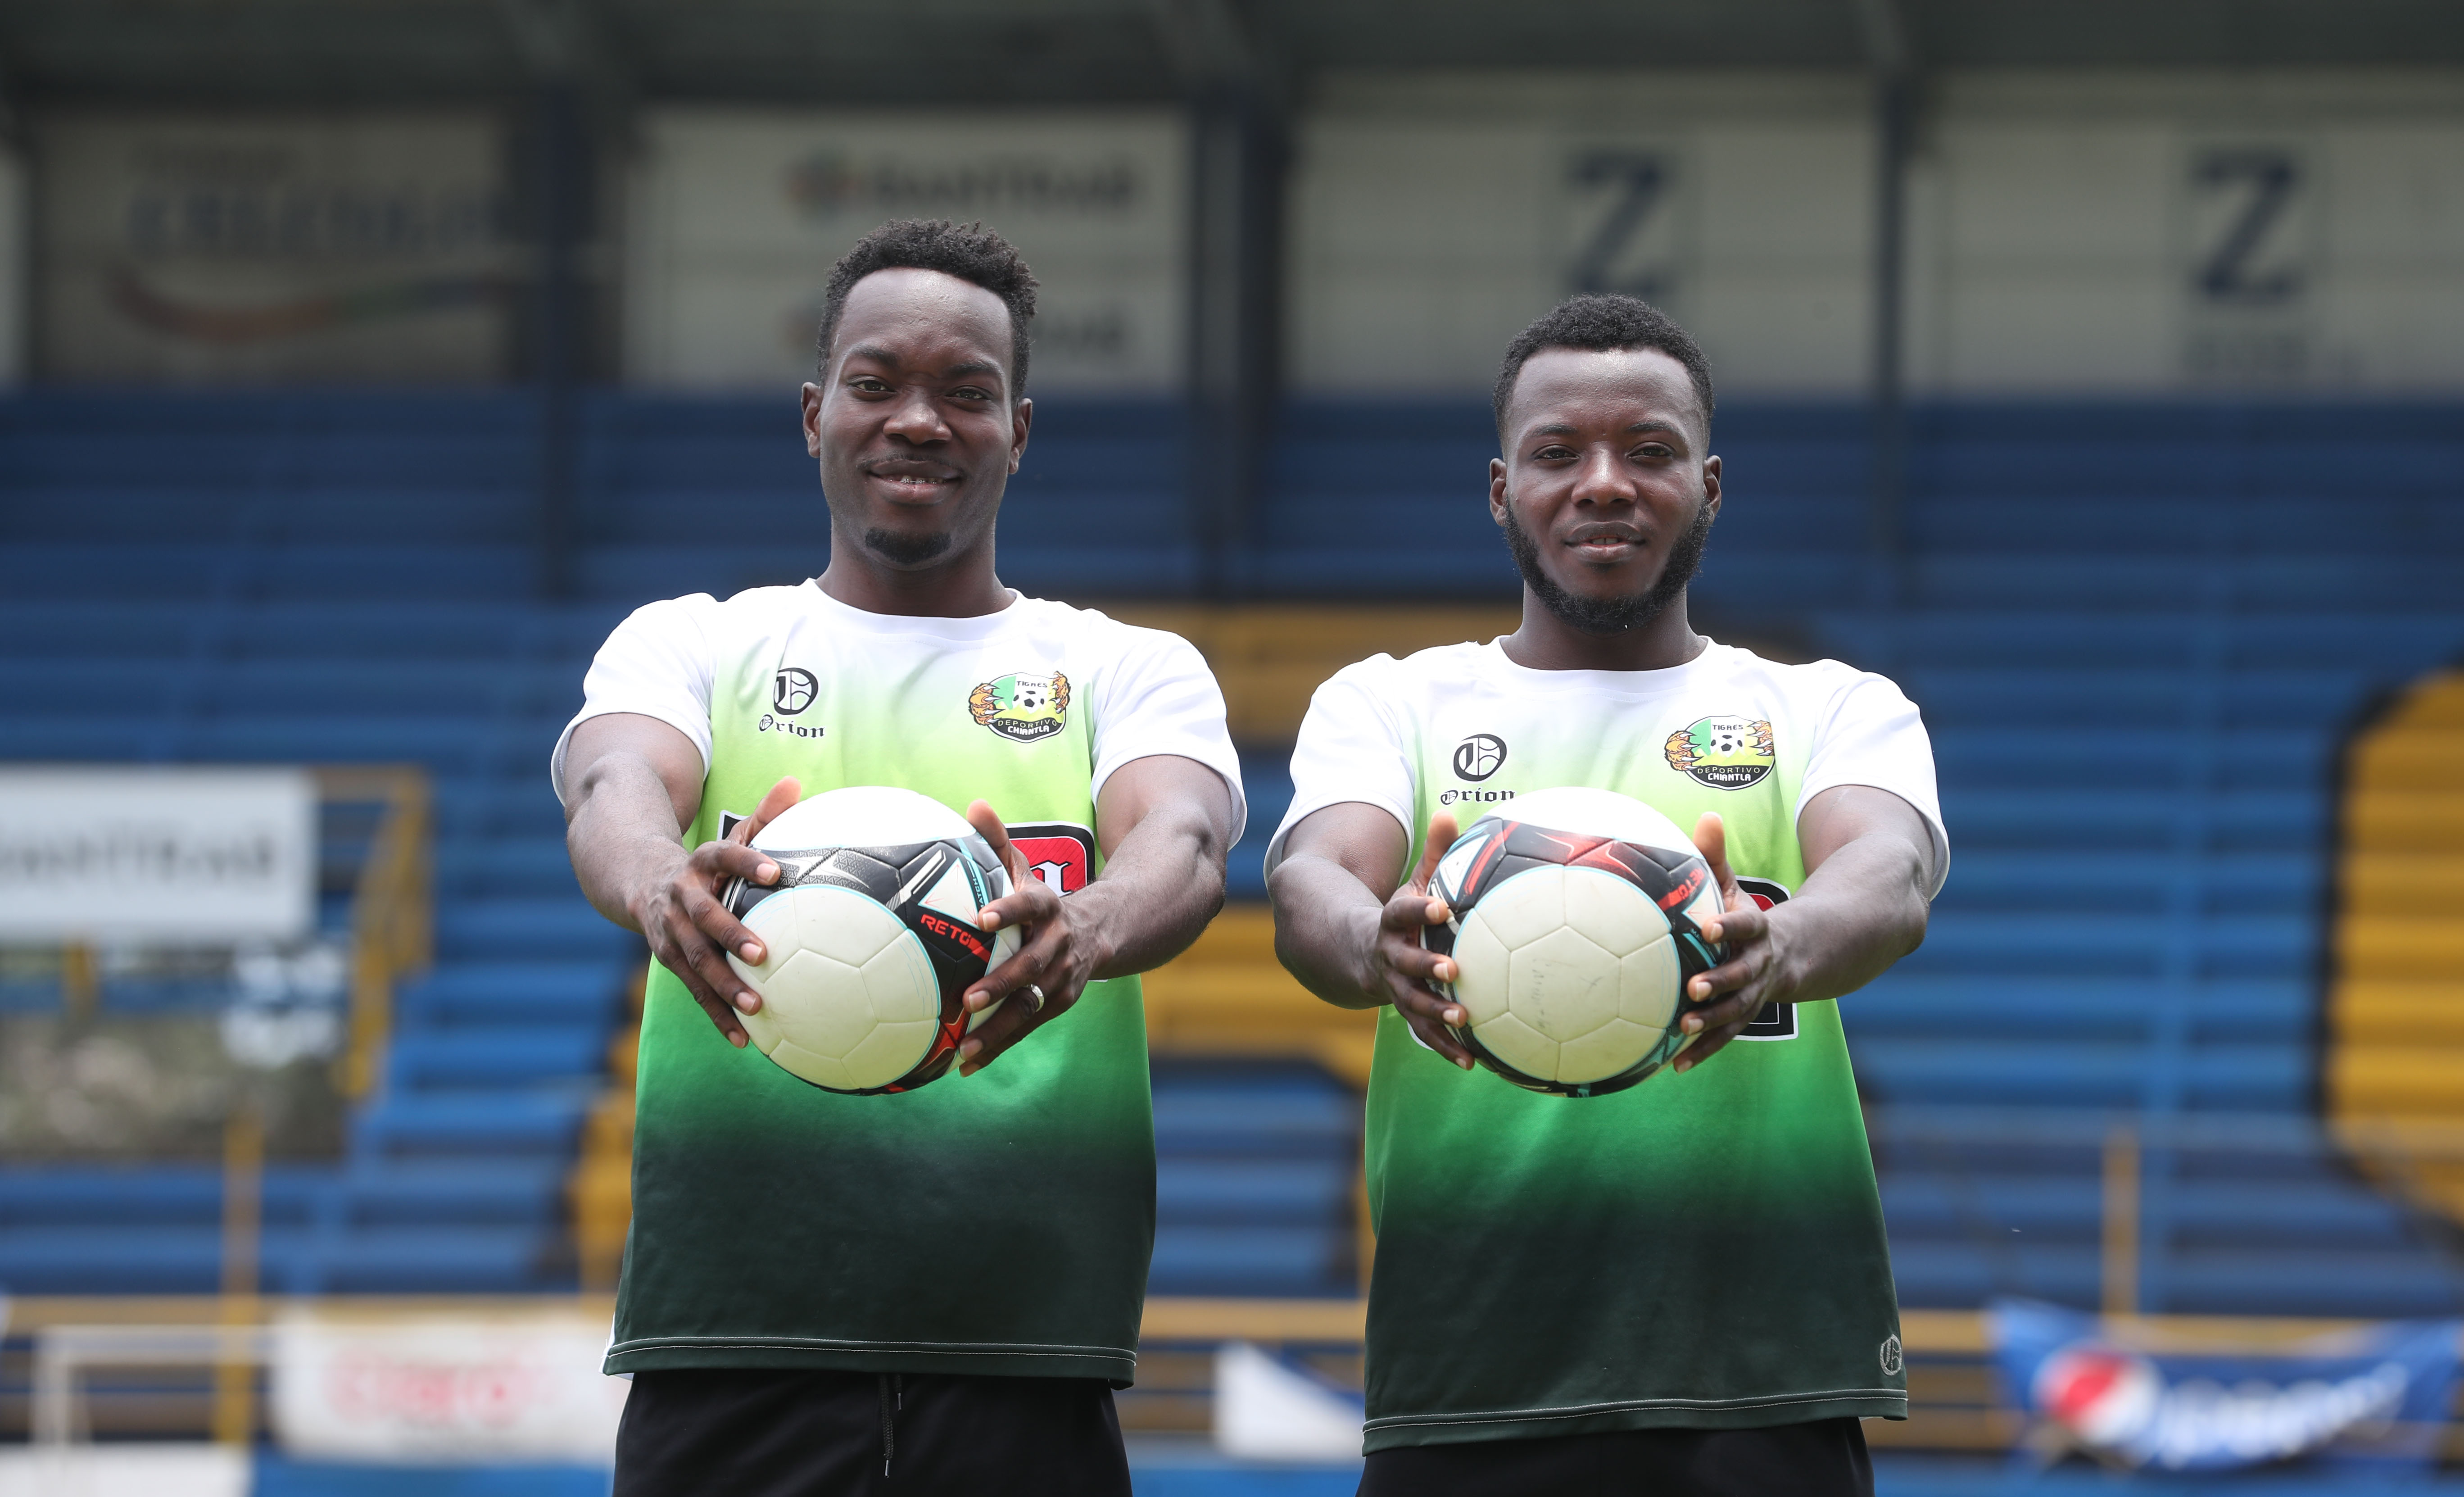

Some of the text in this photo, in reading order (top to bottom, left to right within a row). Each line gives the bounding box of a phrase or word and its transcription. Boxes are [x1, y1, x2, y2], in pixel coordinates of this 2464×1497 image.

[759, 714, 825, 738] Orion
[998, 719, 1057, 728] DEPORTIVO
[1007, 725, 1050, 735] CHIANTLA
[1708, 773, 1751, 781] CHIANTLA
[1440, 788, 1515, 805] Orion
